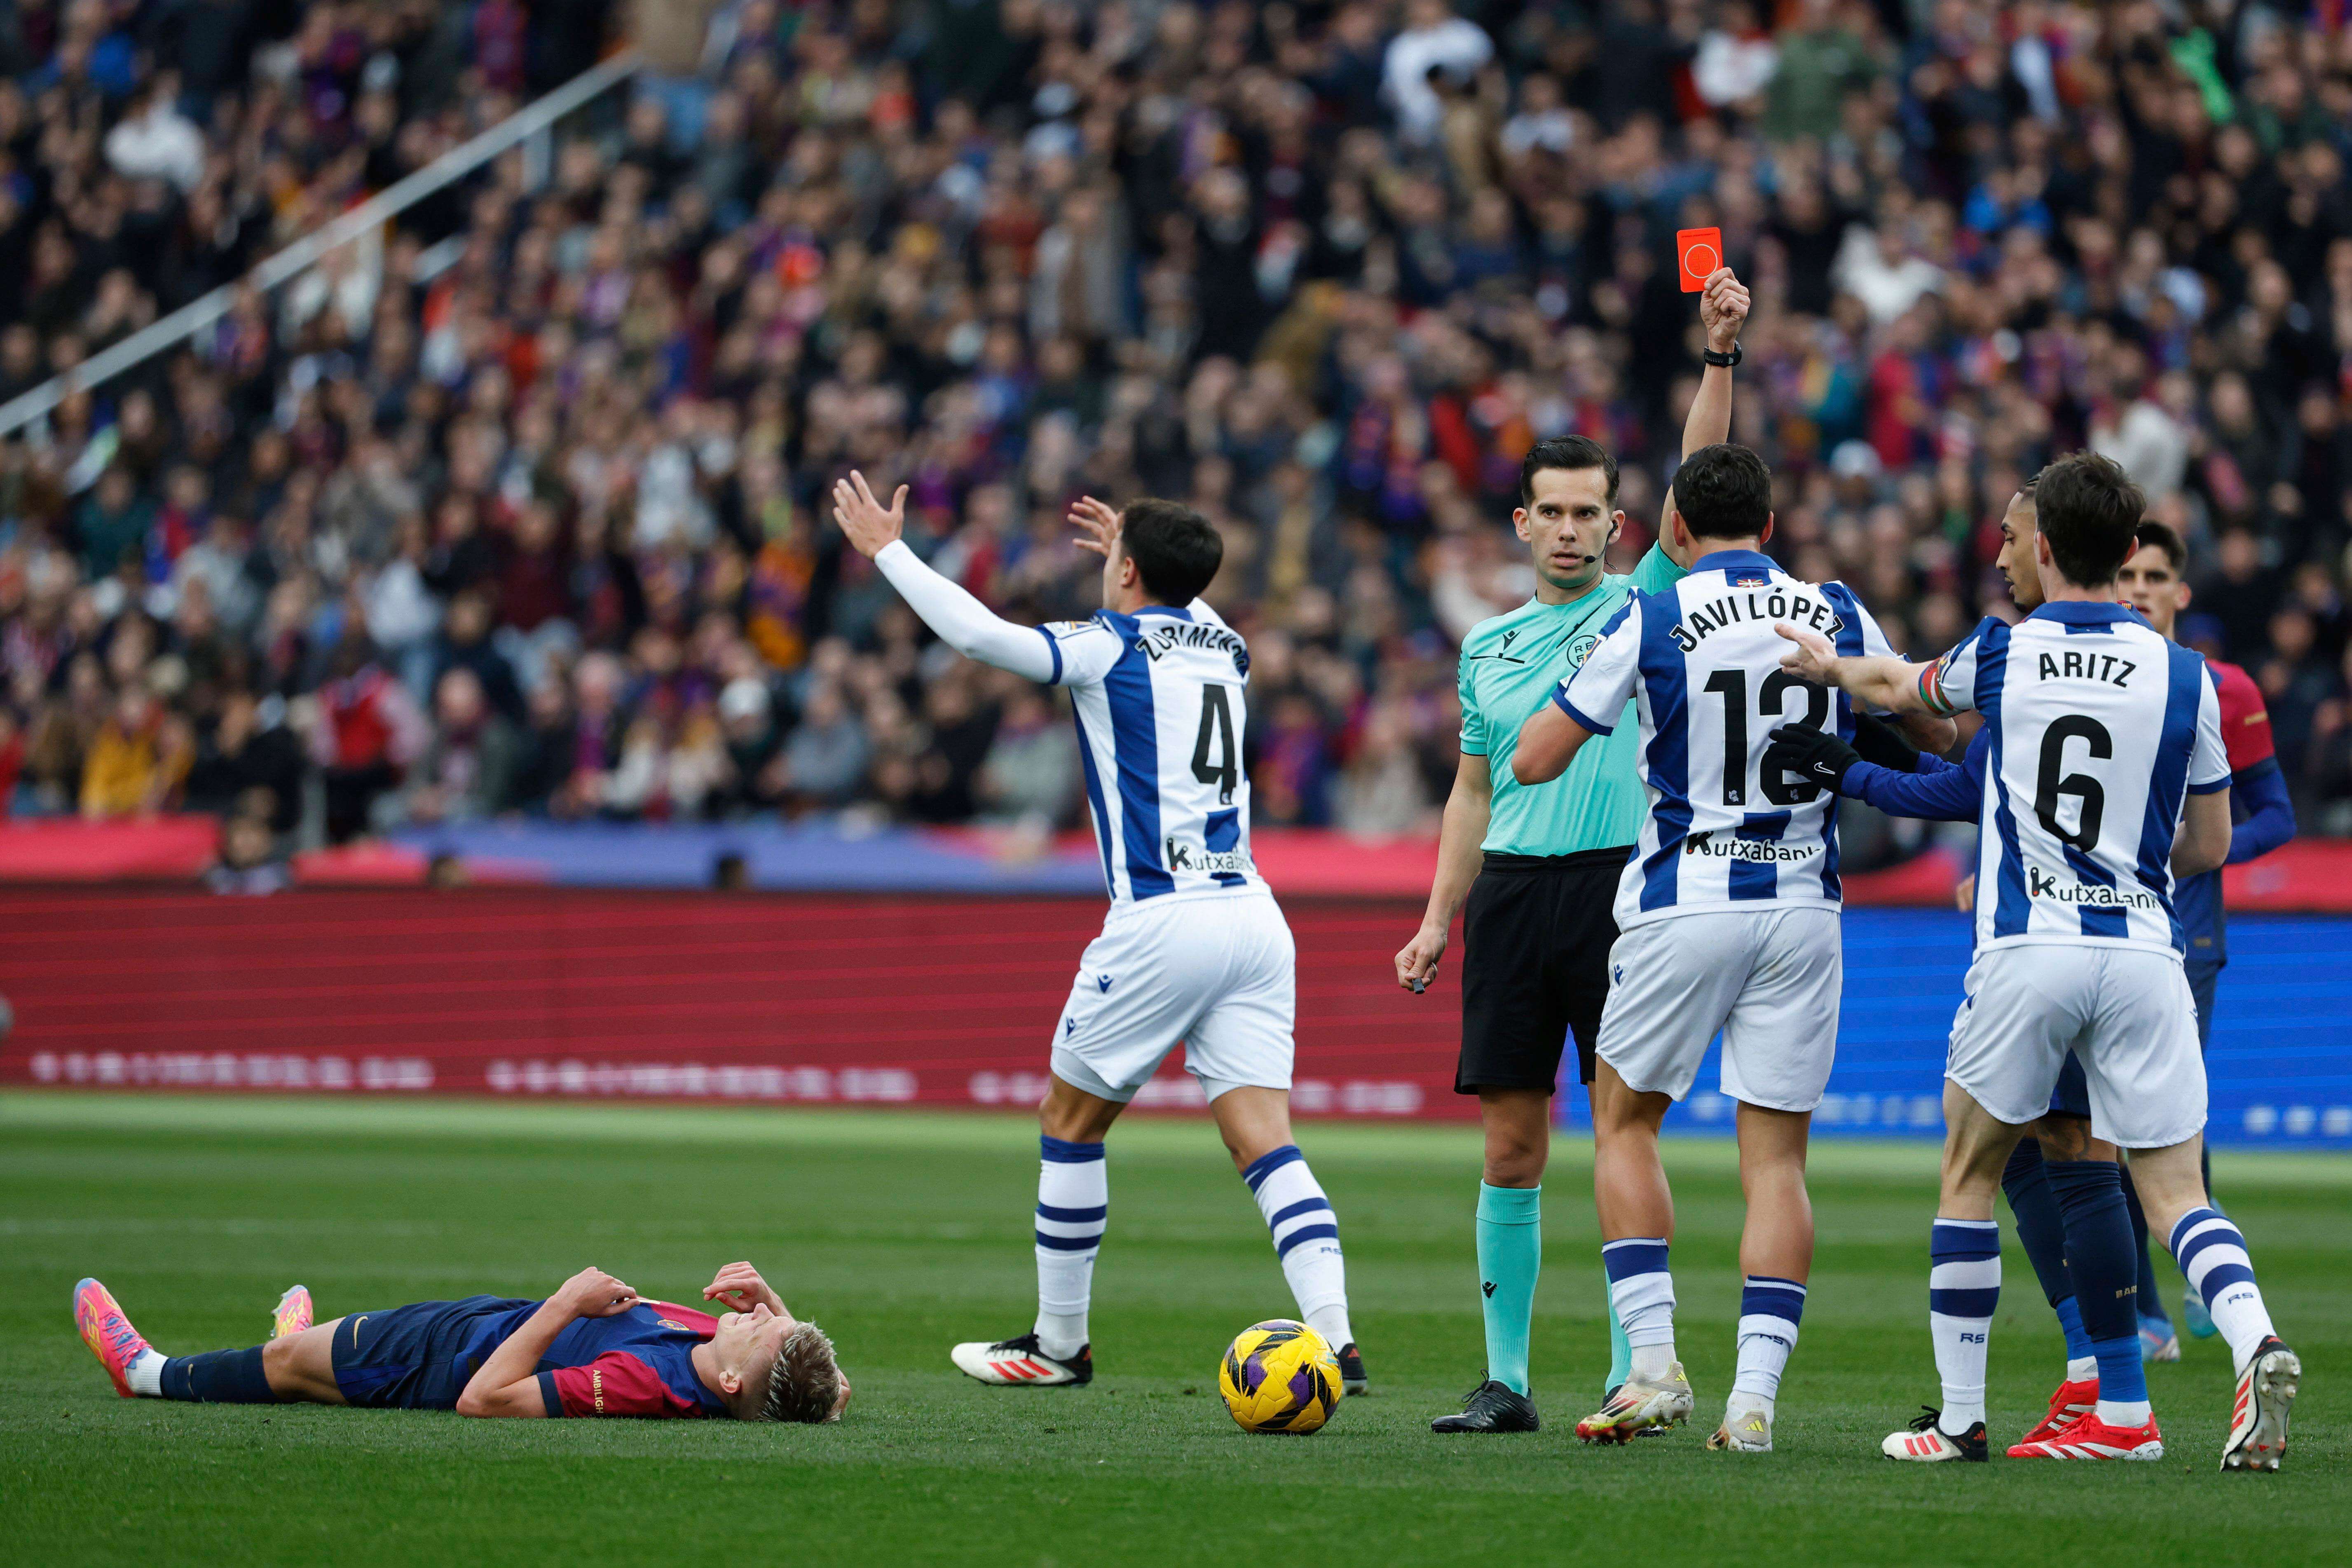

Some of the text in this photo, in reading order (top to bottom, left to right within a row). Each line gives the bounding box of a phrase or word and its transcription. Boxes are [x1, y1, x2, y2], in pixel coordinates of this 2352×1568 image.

[1669, 588, 1845, 652] JAVI LÓPEZ
[2039, 652, 2137, 688] ARITZ
[1191, 684, 1237, 805] 4
[1703, 669, 1829, 806] 12
[2034, 715, 2113, 853] 6
[2228, 1292, 2254, 1305] RS
[1960, 1333, 1985, 1344] RS
[593, 1369, 604, 1413] AMBILIGH
